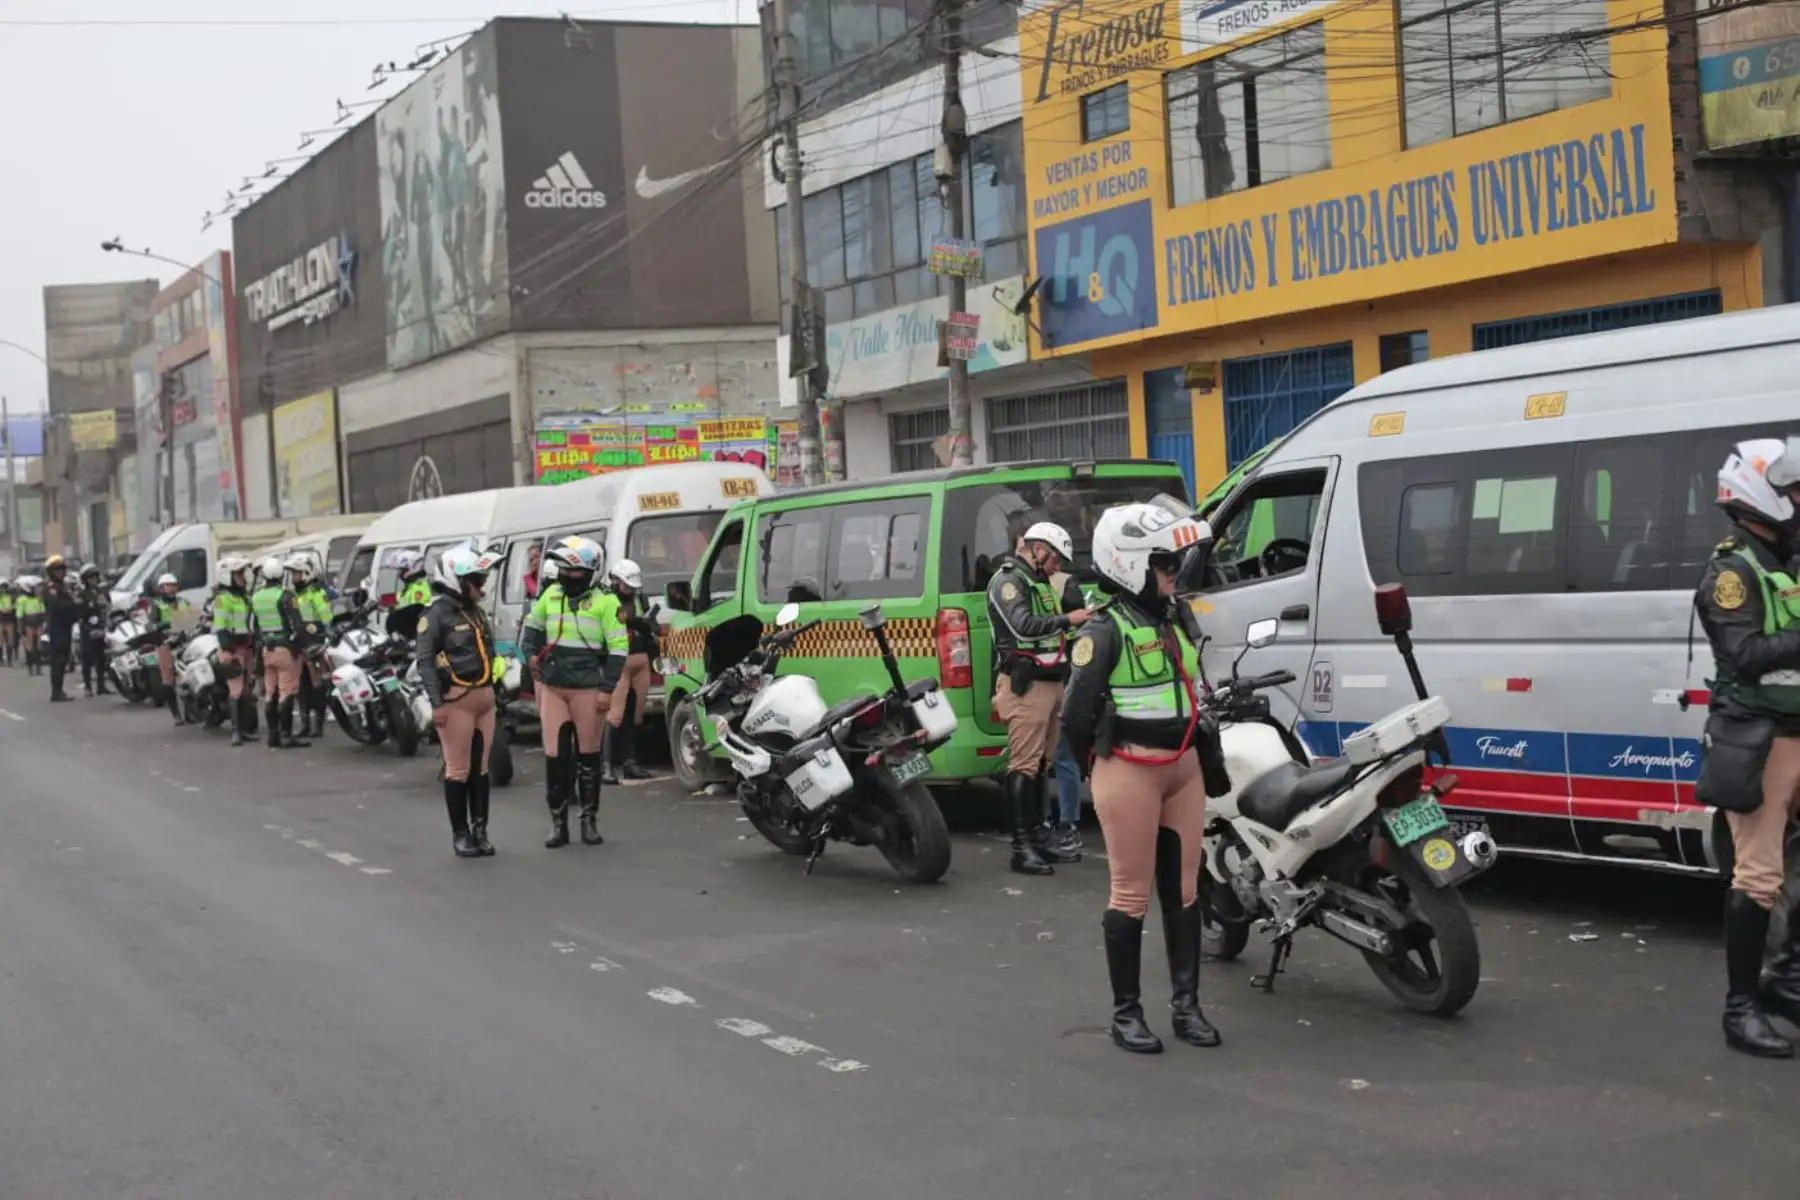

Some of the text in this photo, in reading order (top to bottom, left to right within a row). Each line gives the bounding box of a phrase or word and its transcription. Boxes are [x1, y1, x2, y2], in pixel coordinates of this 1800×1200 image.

[1217, 2, 1270, 35] FRENOS
[1037, 0, 1166, 101] Frenosa
[1060, 67, 1096, 94] FRENOS
[1107, 41, 1169, 80] EMBRAGUES
[1045, 141, 1132, 185] VENTAS POR
[525, 186, 607, 209] adidas
[1033, 168, 1149, 220] MAYOR Y MENOR
[1165, 123, 1656, 307] FRENOS Y EMBRAGUES UNIVERSAL
[244, 236, 340, 322] TRIATHLON
[1312, 669, 1332, 693] D2
[1476, 736, 1528, 759] Faucett
[1608, 745, 1695, 775] Aeropuerto
